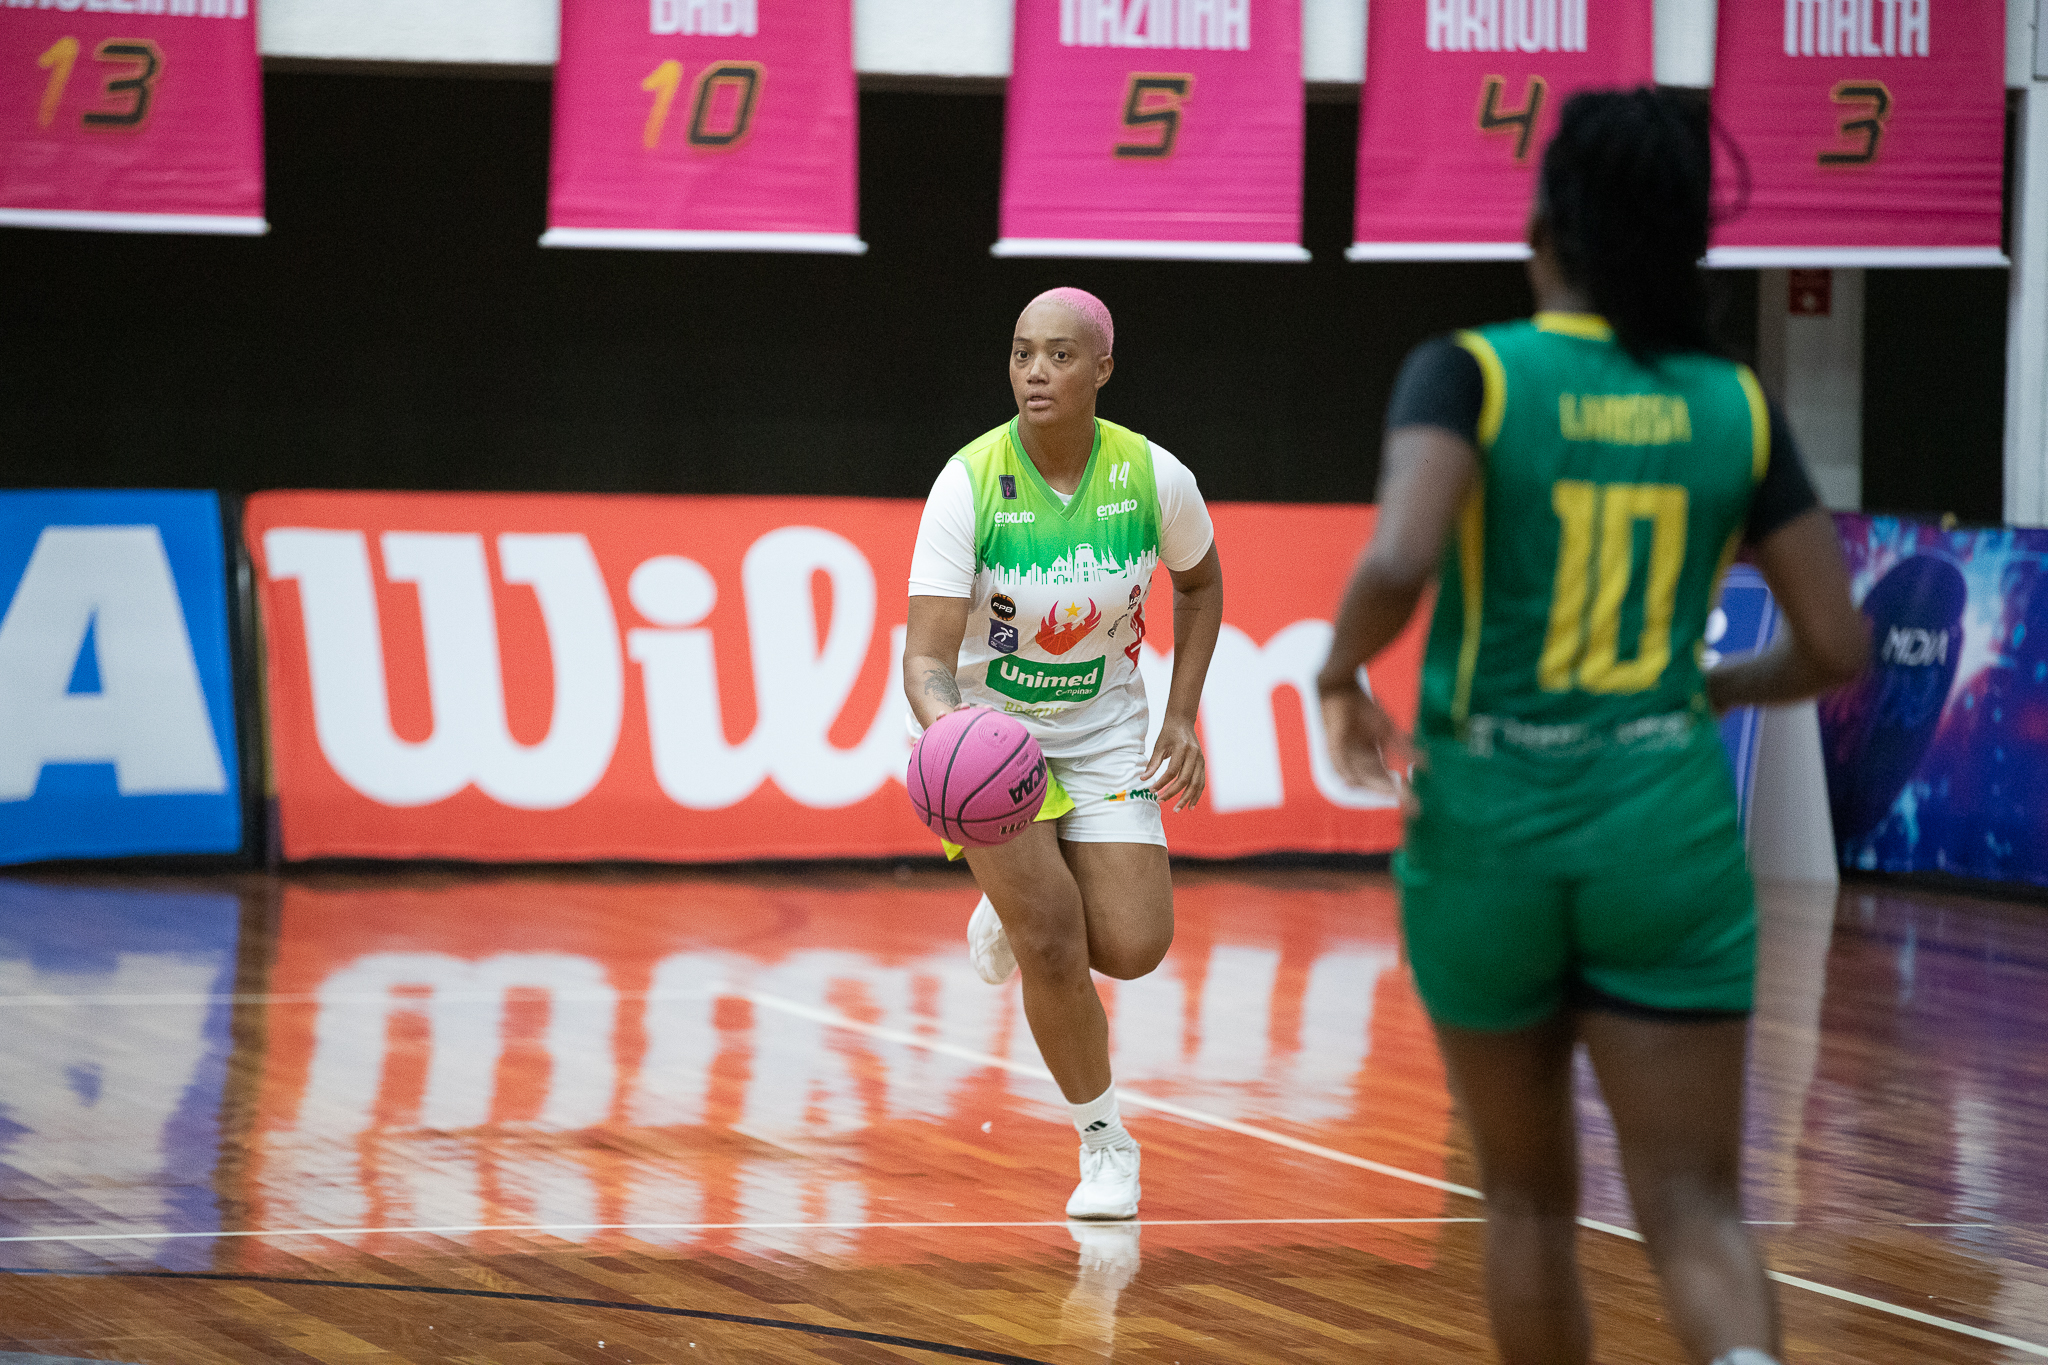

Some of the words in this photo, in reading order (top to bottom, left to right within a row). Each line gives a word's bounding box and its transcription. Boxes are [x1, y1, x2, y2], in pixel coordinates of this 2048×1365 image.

[1784, 0, 1930, 57] MALTA
[37, 37, 163, 133] 13
[641, 59, 767, 151] 10
[1112, 72, 1196, 160] 5
[1477, 74, 1548, 161] 4
[1816, 80, 1893, 167] 3
[994, 510, 1036, 524] enxuto
[1096, 499, 1138, 518] enxuto
[1109, 461, 1130, 490] 44
[1537, 479, 1690, 695] 10
[263, 523, 1402, 815] Wiln
[1000, 660, 1098, 689] Unimed
